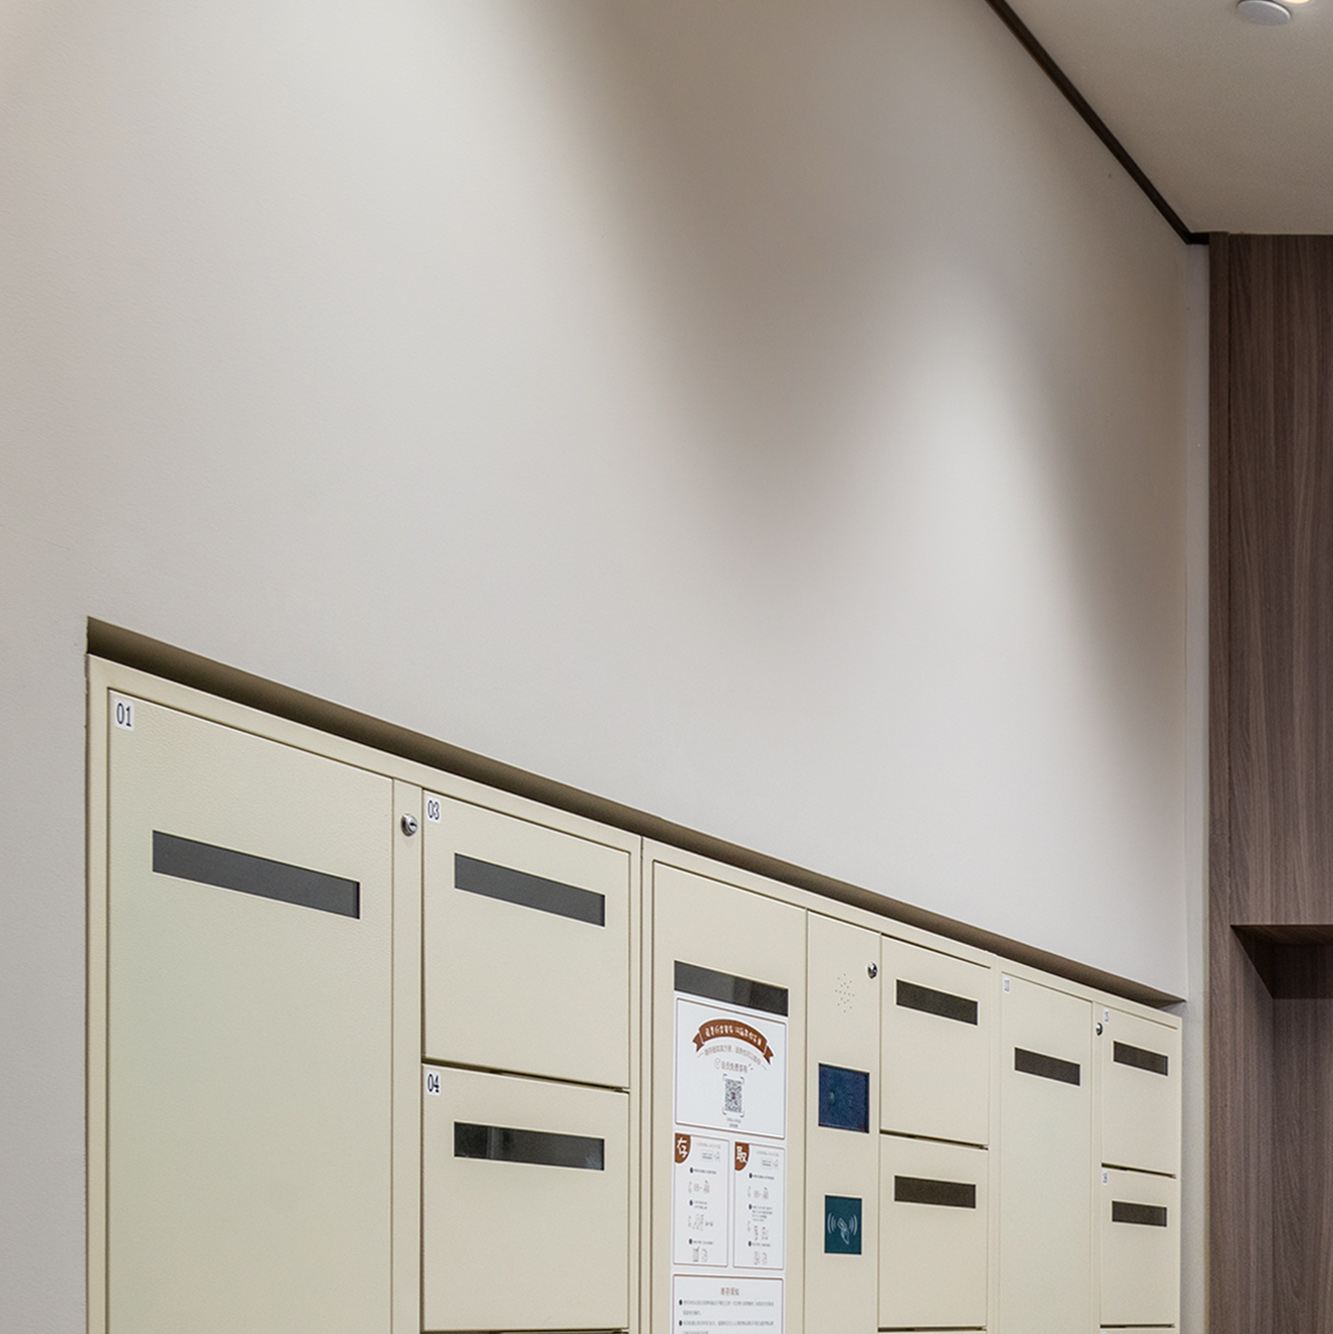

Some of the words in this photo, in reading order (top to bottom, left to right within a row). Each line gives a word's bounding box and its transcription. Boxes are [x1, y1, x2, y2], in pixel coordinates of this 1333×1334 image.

[116, 702, 132, 728] 01
[428, 799, 440, 821] 03
[427, 1073, 440, 1094] 04
